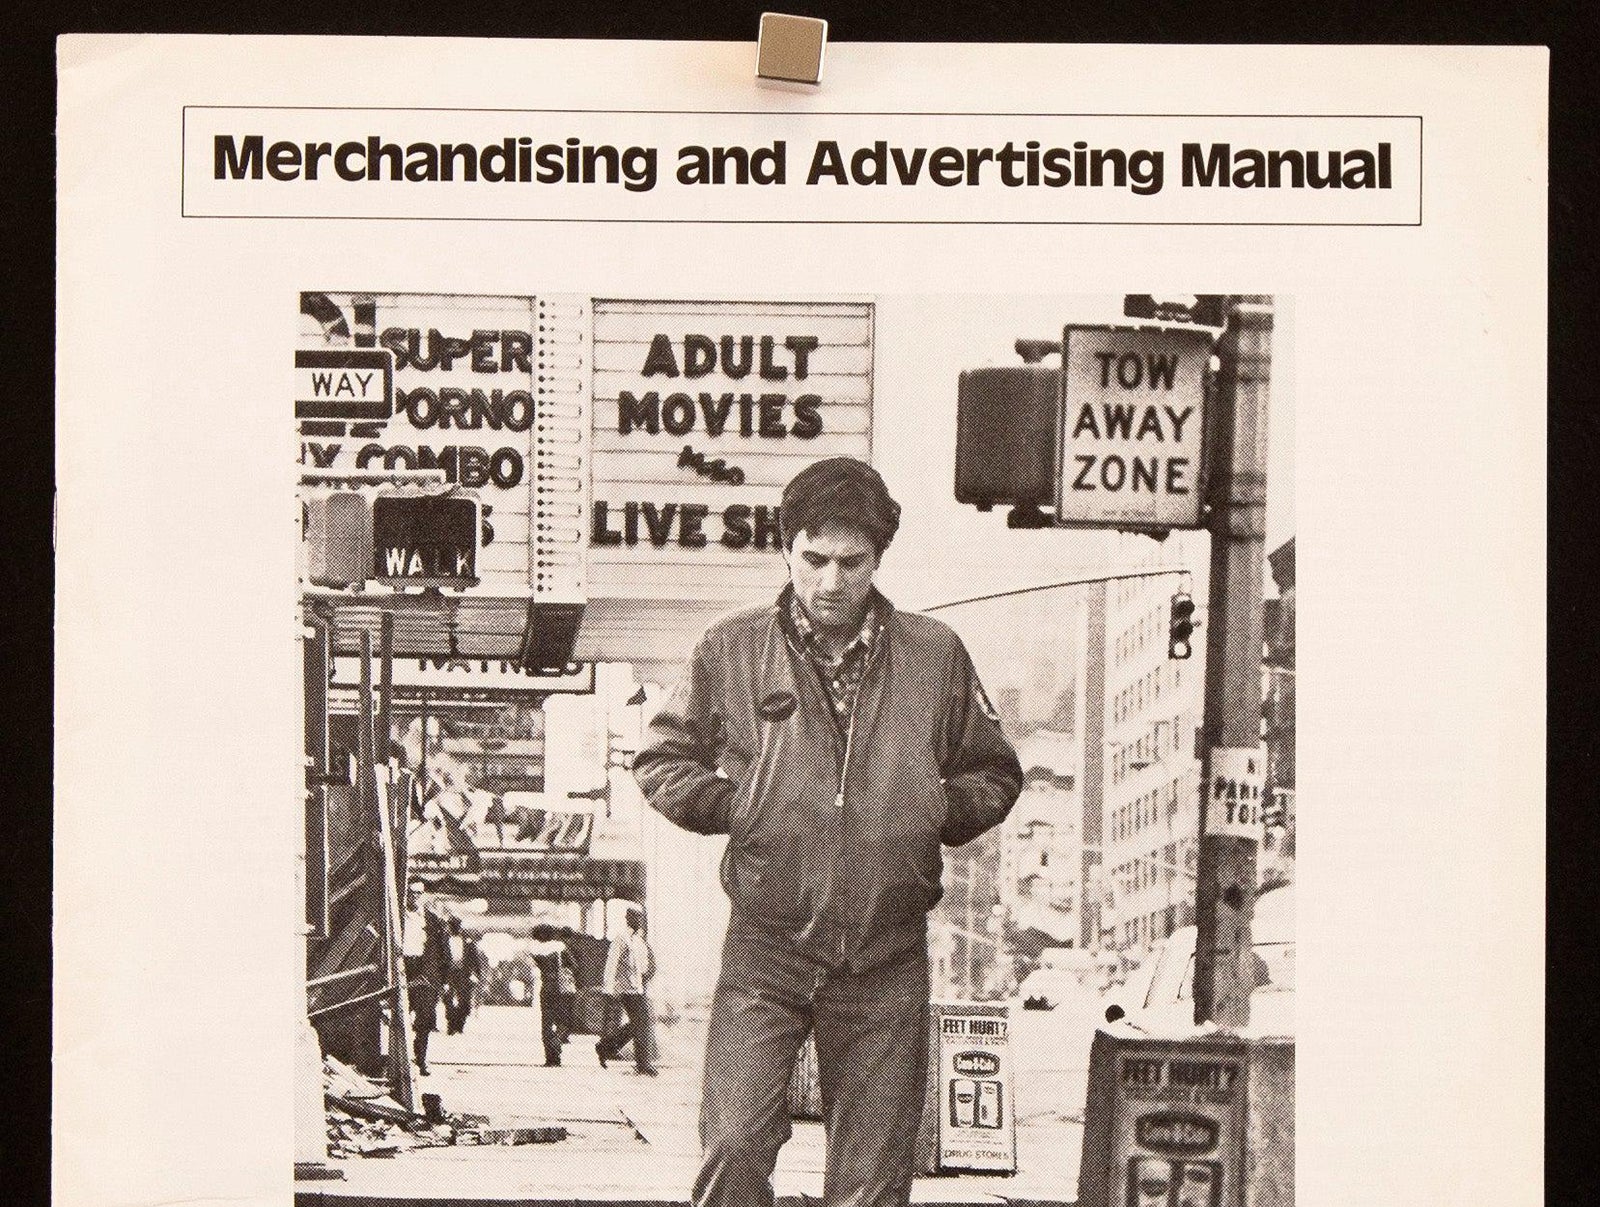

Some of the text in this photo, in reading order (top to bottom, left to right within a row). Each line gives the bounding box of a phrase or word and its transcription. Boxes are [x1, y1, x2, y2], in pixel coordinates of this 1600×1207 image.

[213, 134, 1393, 195] Merchandising and Advertising Manual
[380, 327, 533, 374] SUPER
[641, 334, 818, 381] ADULT
[1094, 352, 1178, 391] TOW
[312, 372, 374, 397] WAY
[618, 391, 823, 439] MOVIES
[1072, 402, 1194, 443] AWAY
[356, 443, 523, 489] COMBO
[1072, 454, 1190, 495] ZONE
[591, 500, 708, 549] LIVE
[383, 545, 472, 572] WALK
[943, 1019, 966, 1034] FEET
